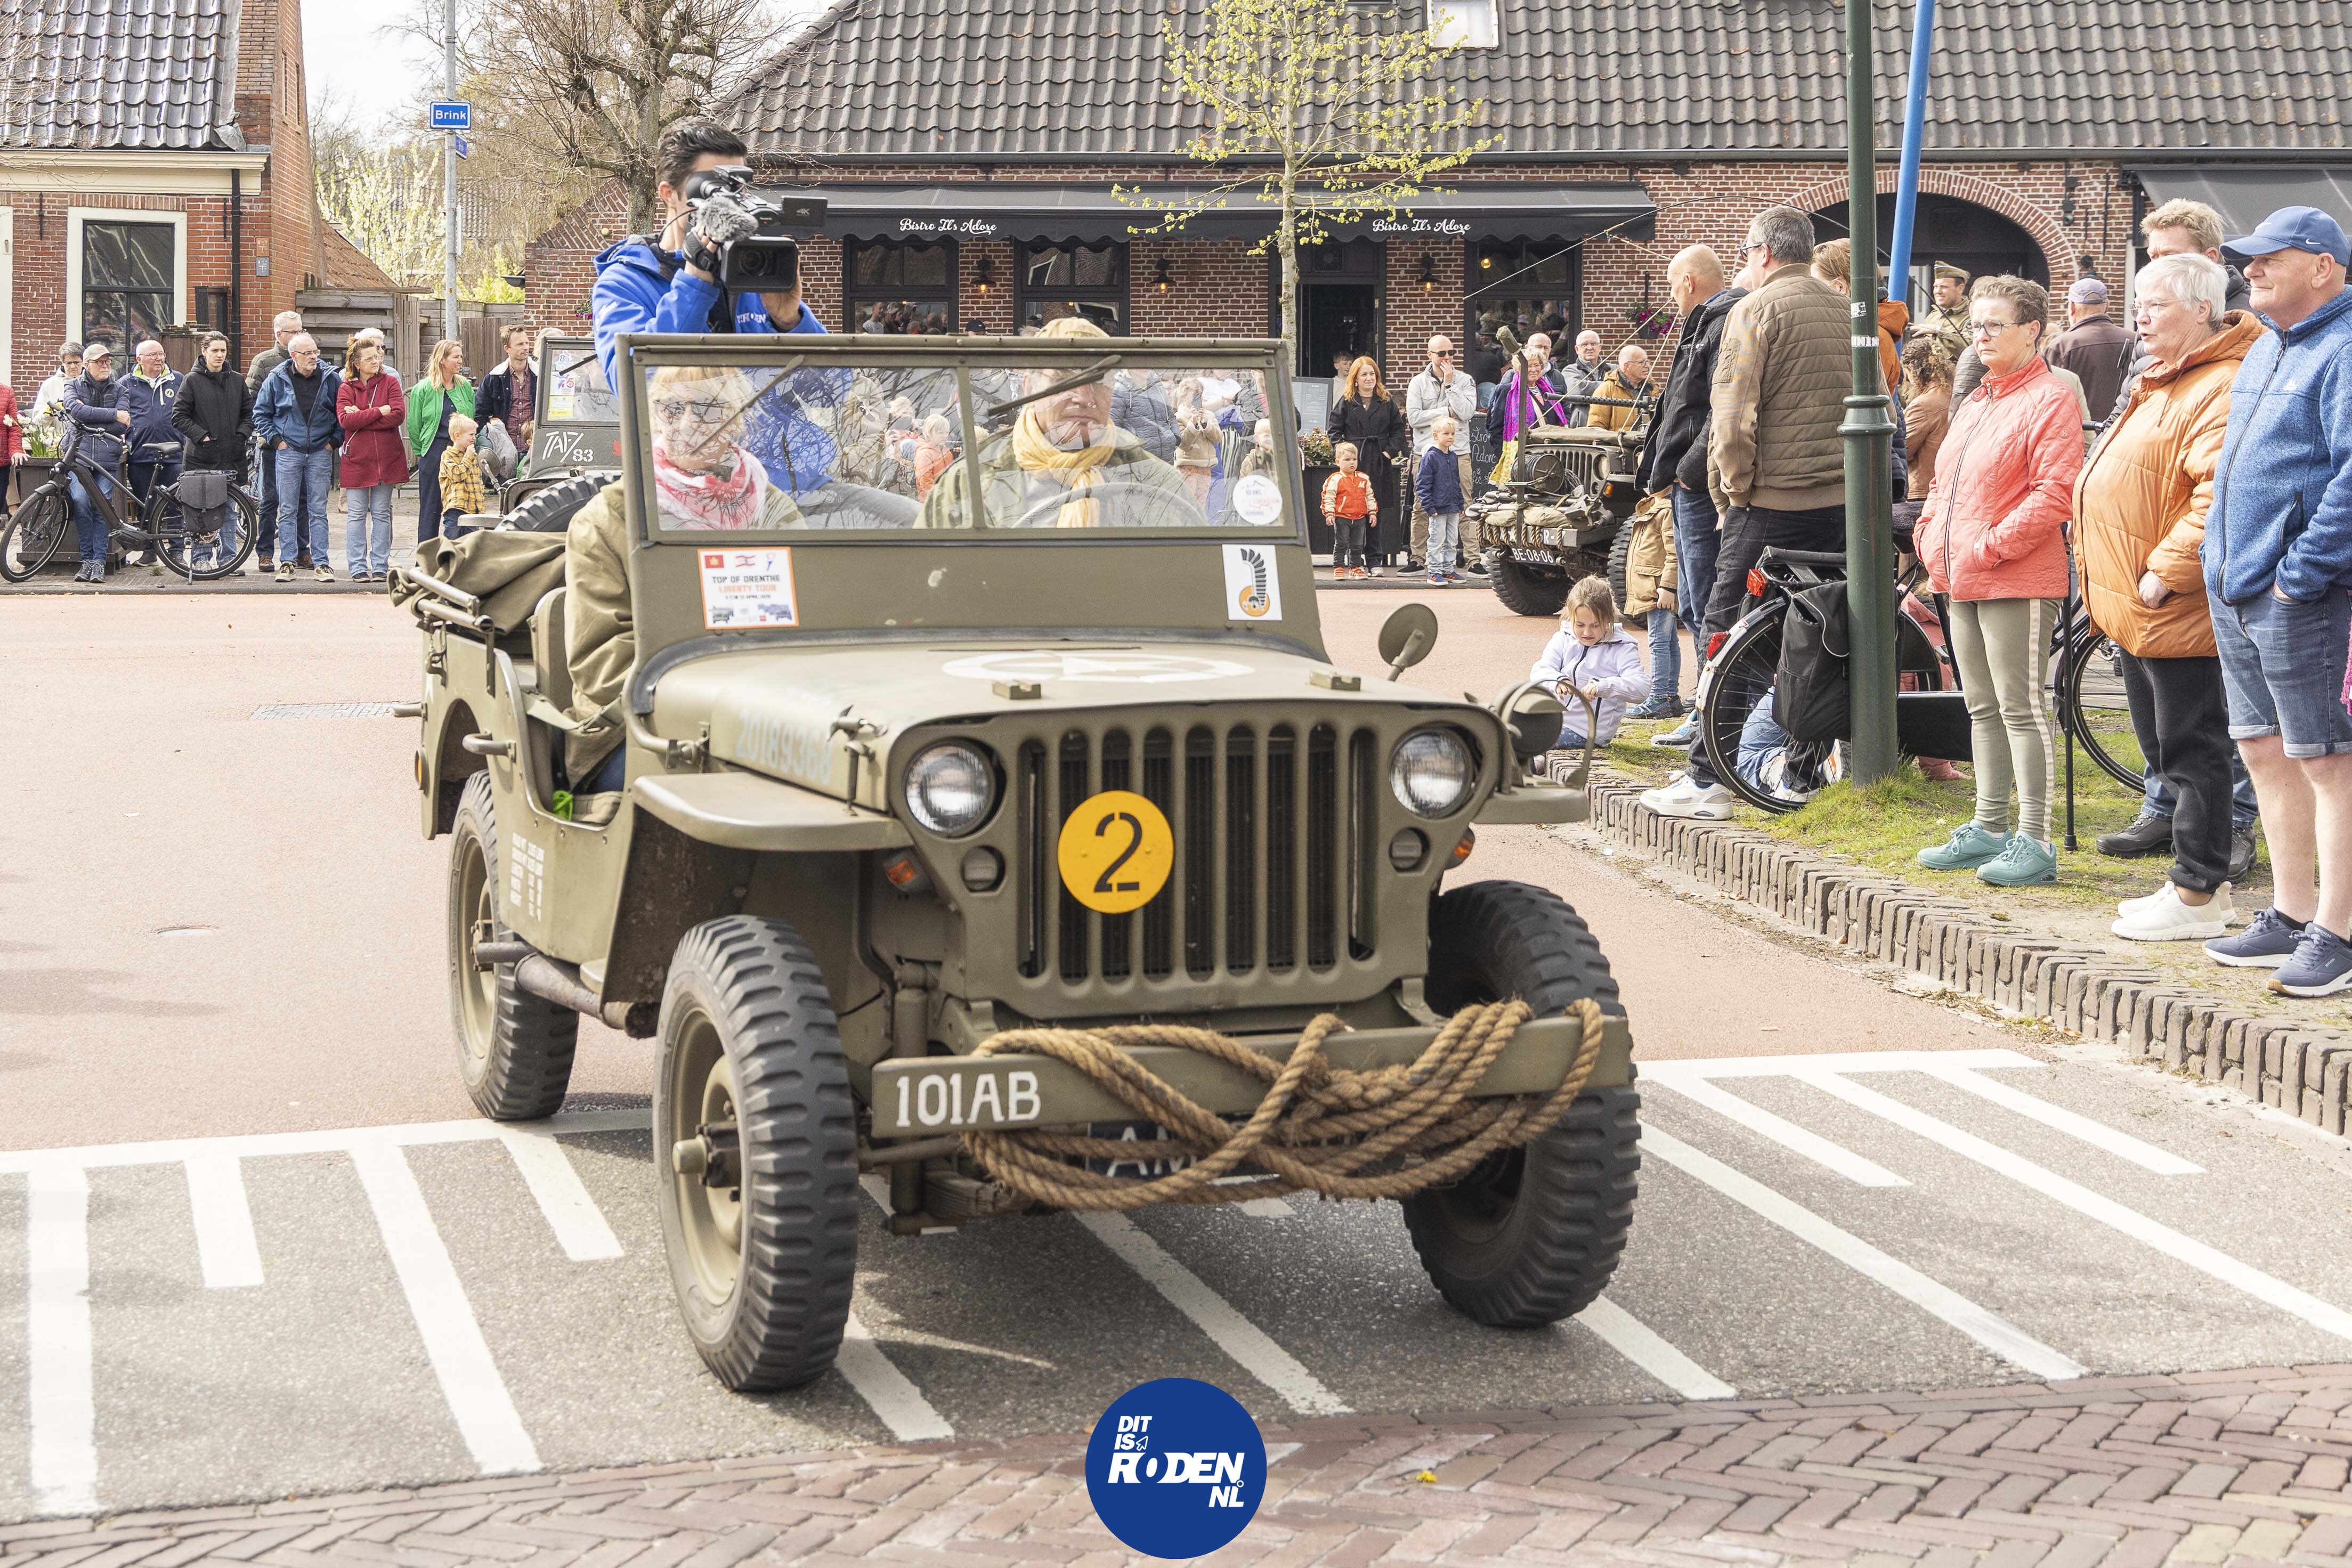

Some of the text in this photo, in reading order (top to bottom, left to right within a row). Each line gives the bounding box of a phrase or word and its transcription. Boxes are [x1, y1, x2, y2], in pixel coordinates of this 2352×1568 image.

[435, 110, 466, 120] Brink
[899, 218, 936, 231] Bistro
[960, 218, 997, 235] Adore
[1373, 219, 1409, 231] Bistro
[1433, 219, 1471, 235] Adore
[1472, 443, 1497, 464] Adore
[1094, 812, 1142, 892] 2
[896, 1071, 1041, 1127] 101AB
